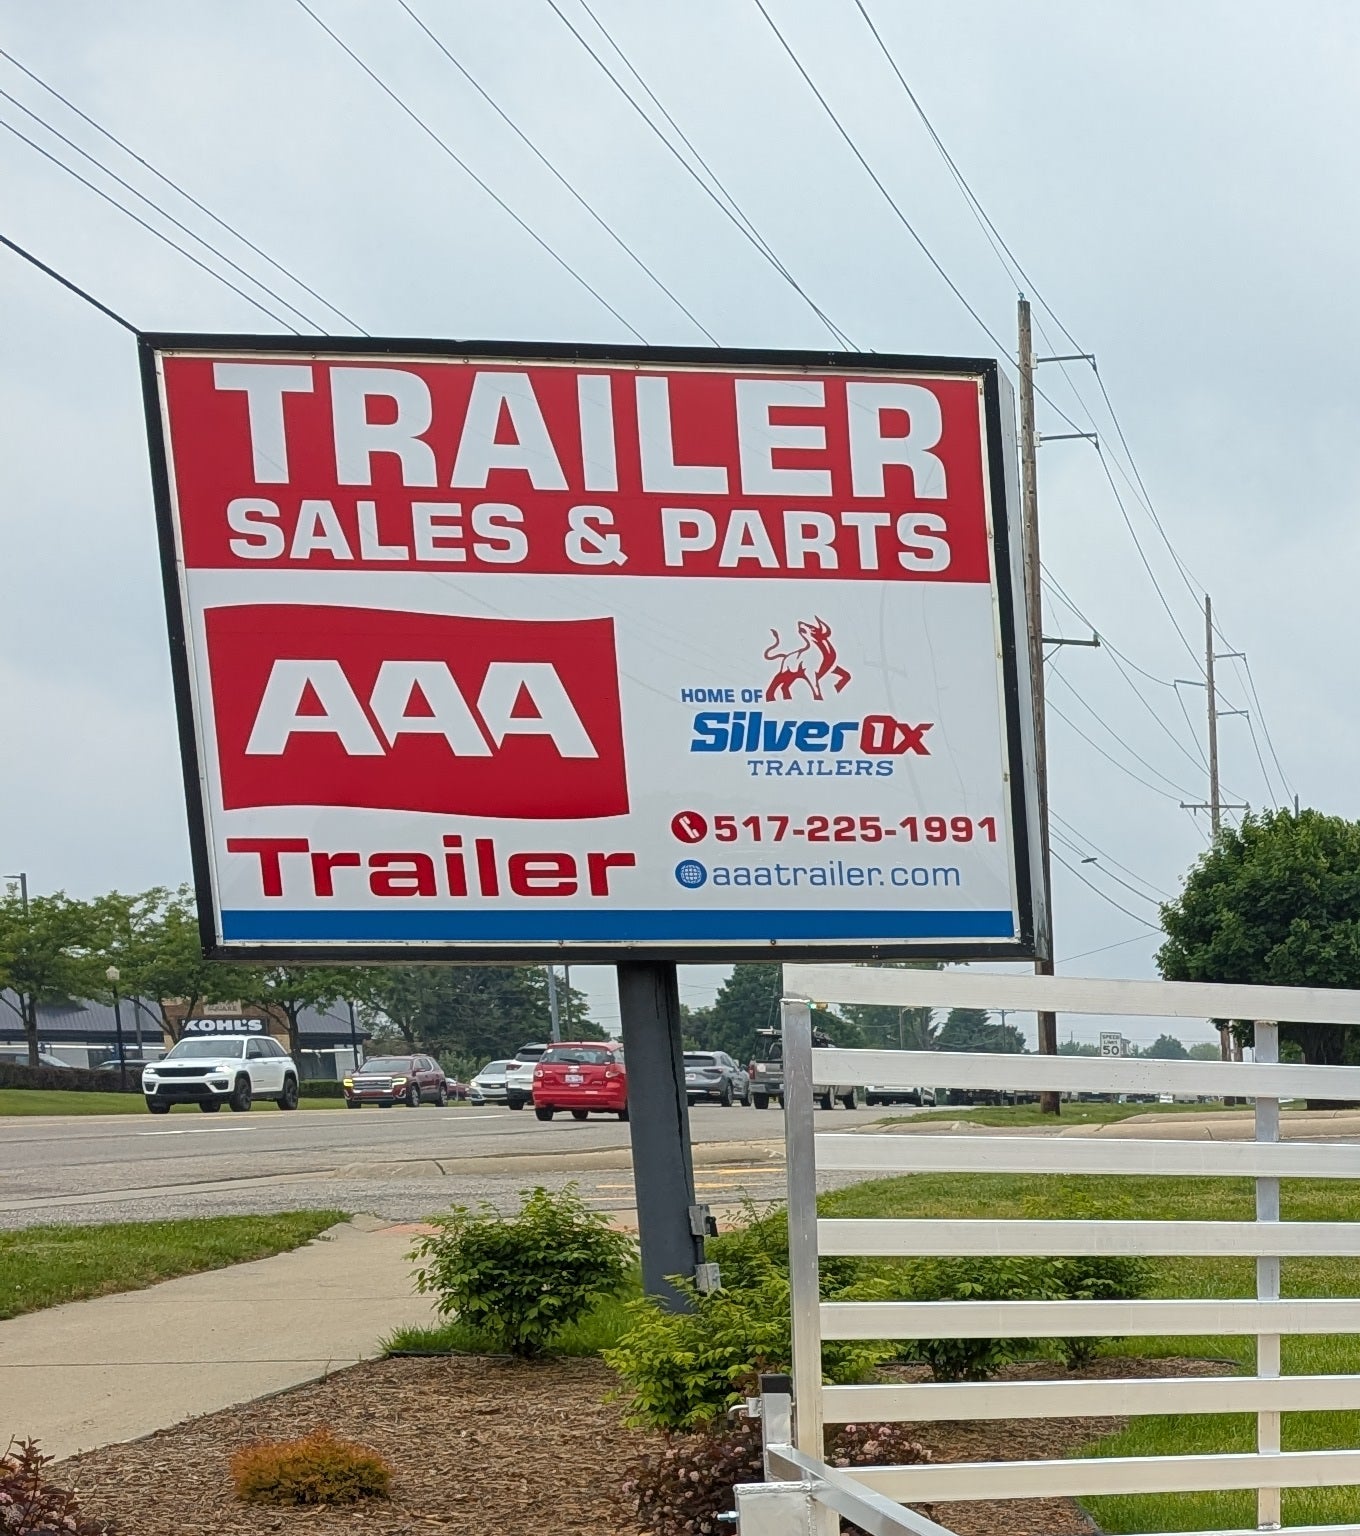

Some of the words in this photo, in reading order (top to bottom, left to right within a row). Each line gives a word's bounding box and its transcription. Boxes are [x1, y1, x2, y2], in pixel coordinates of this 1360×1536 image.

[213, 362, 949, 499] TRAILER
[227, 498, 529, 563] SALES
[564, 505, 628, 566] &
[661, 507, 951, 572] PARTS
[246, 659, 598, 758] AAA
[681, 688, 735, 704] HOME
[742, 688, 762, 704] OF
[748, 759, 894, 777] TRAILERS
[714, 816, 997, 842] 517-225-1991
[226, 834, 636, 897] Trailer
[712, 860, 960, 886] aaatrailer.com
[1103, 1045, 1119, 1055] 50
